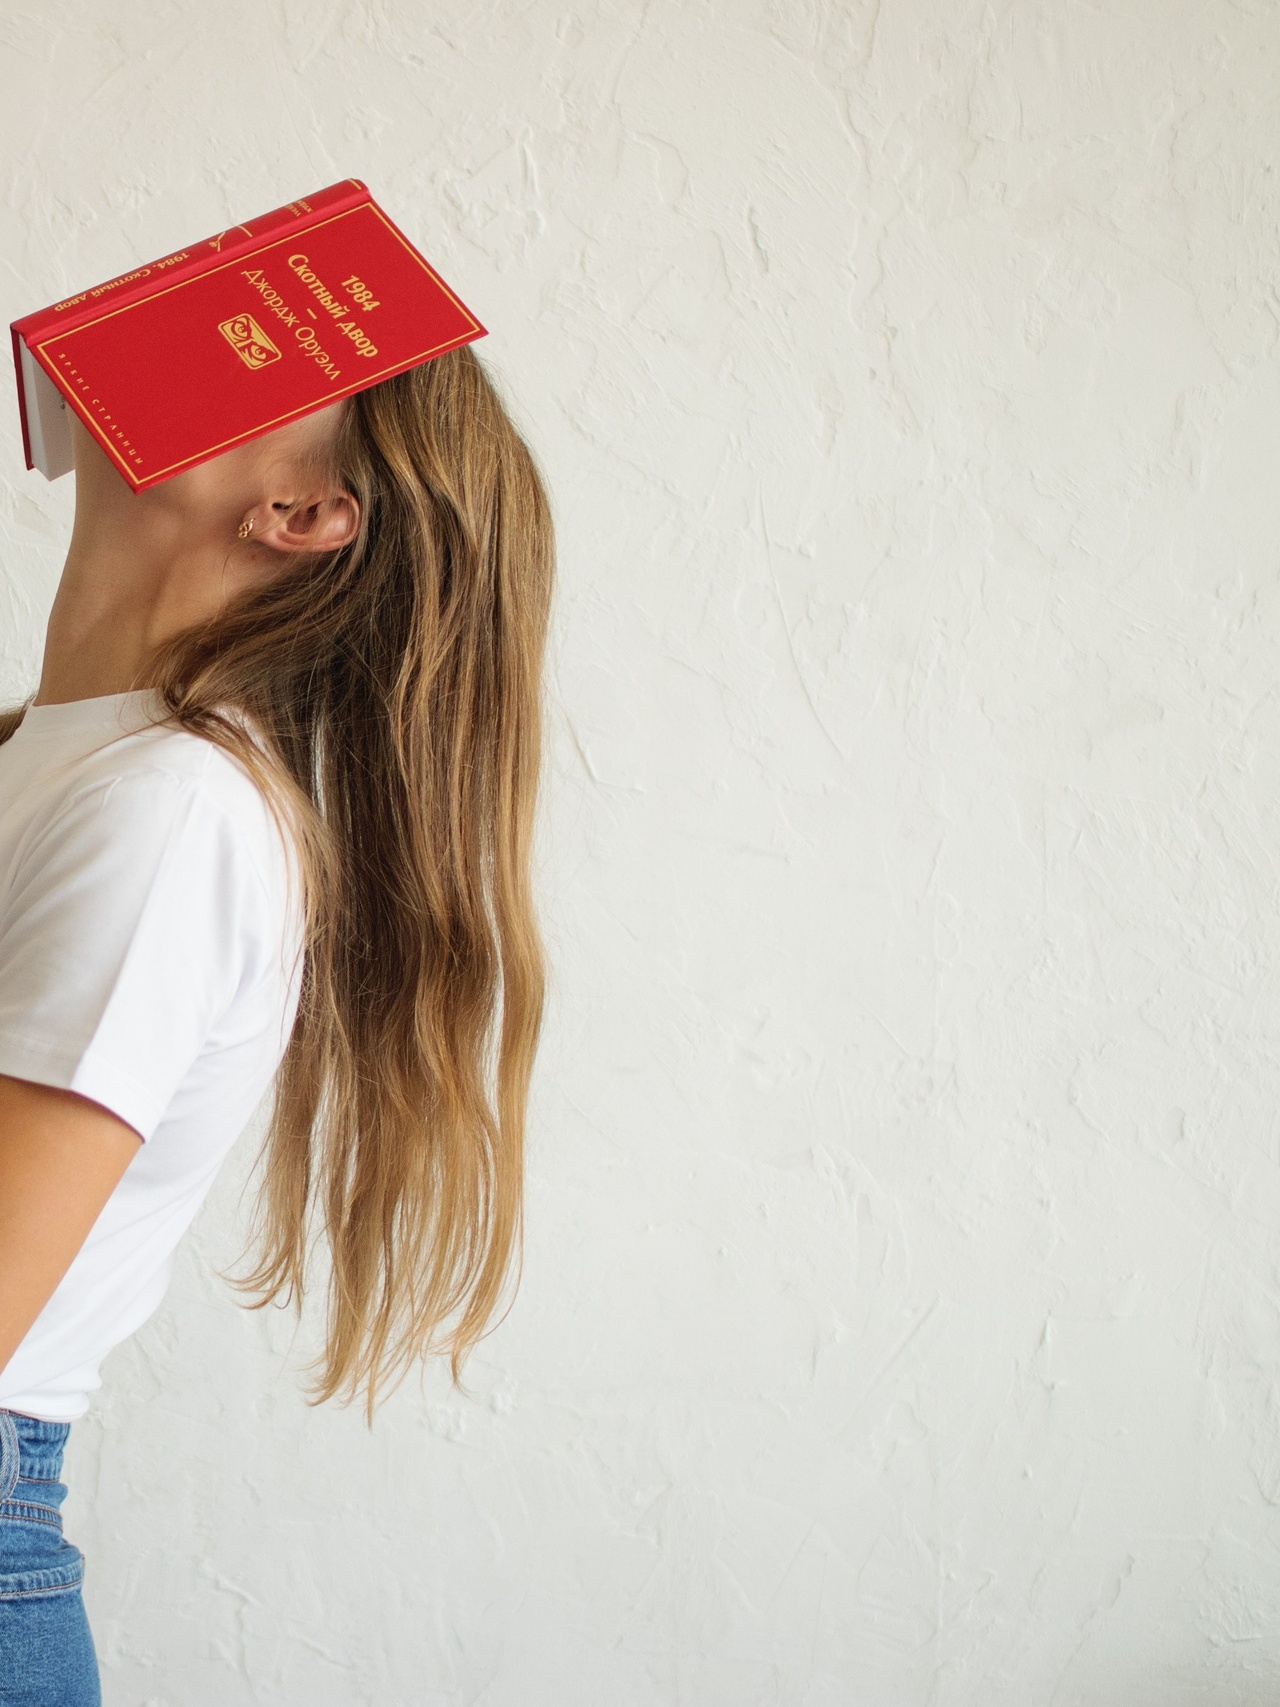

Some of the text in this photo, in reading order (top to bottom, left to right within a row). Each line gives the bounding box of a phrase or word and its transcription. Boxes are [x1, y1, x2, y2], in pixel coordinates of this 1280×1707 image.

[54, 252, 190, 311] 1984. Скотный двор
[240, 269, 341, 381] Джордж Оруэлл
[287, 254, 378, 358] Скотный двор
[341, 275, 380, 312] 1984
[58, 353, 143, 464] ЯРКИЕ СТРАНИЦЫ
